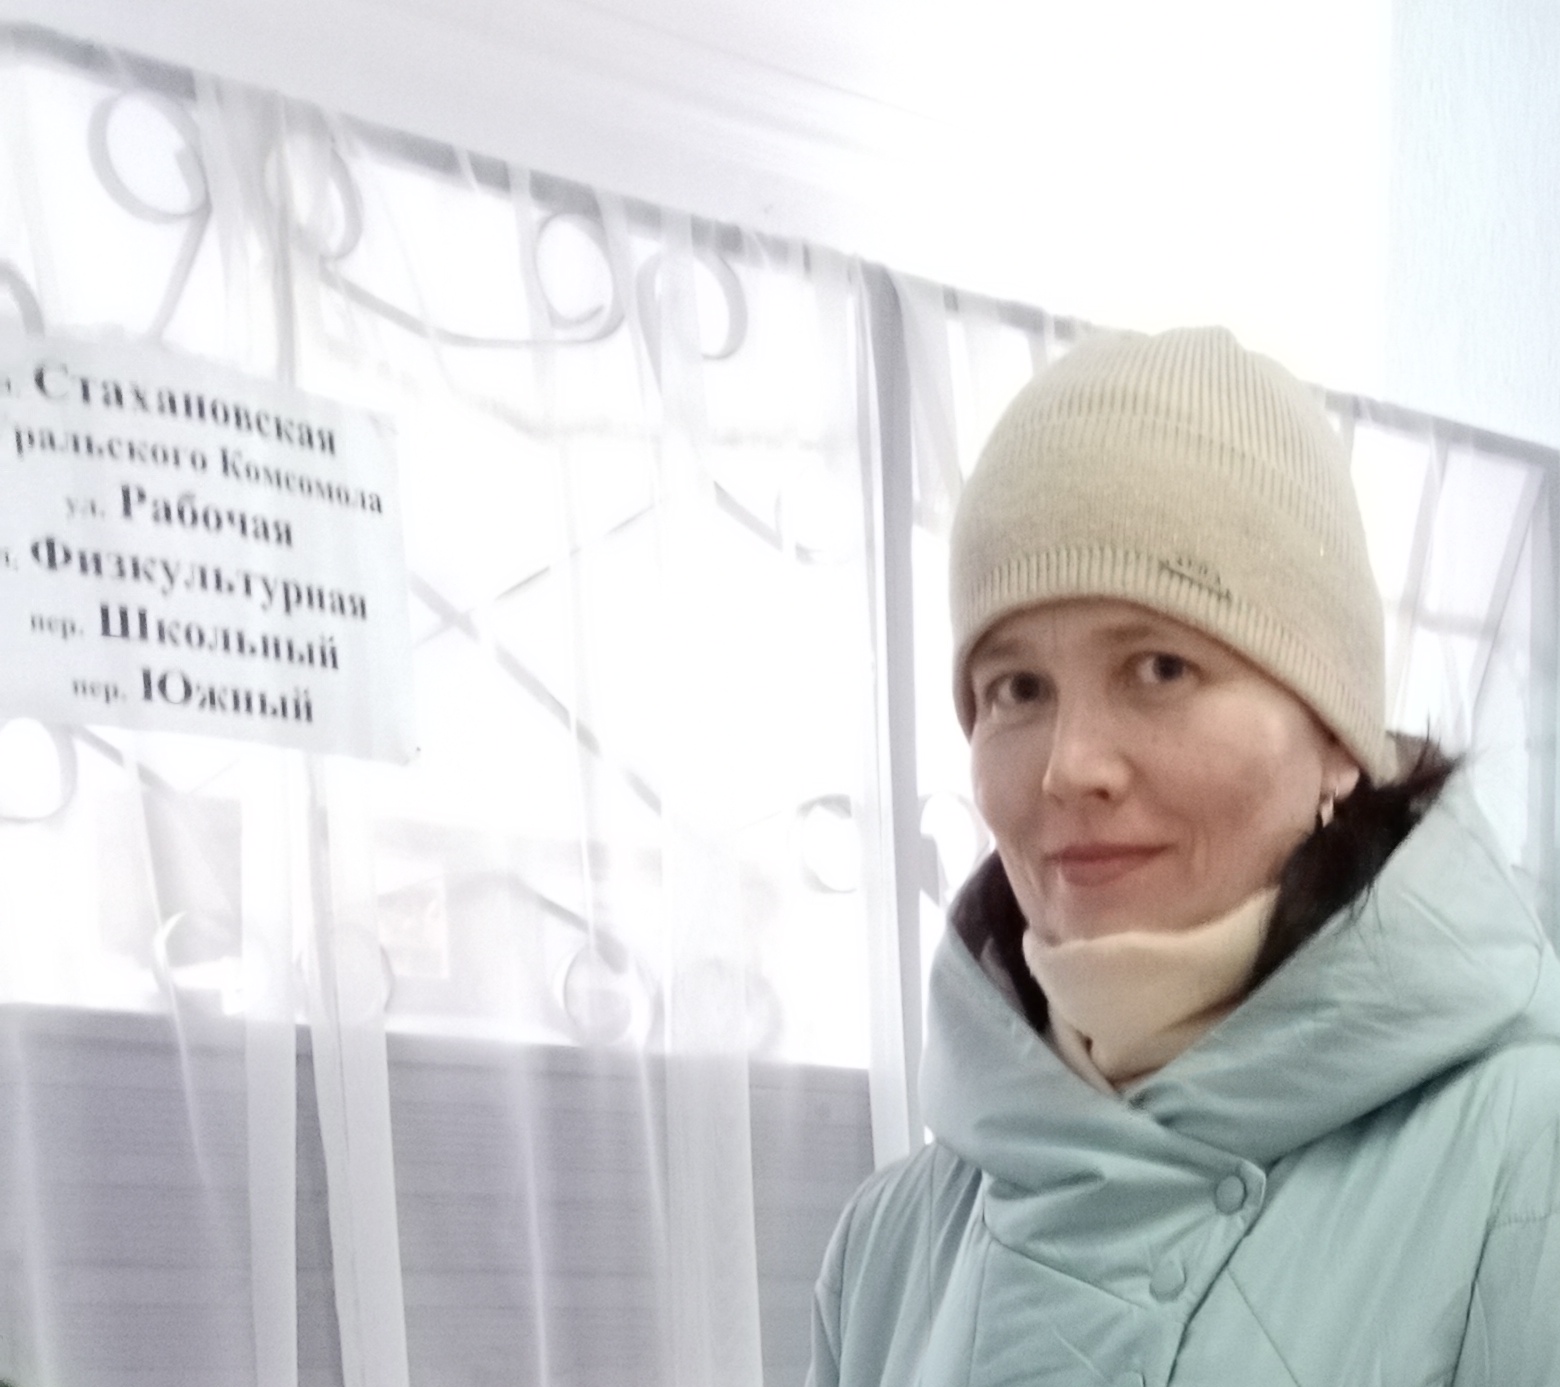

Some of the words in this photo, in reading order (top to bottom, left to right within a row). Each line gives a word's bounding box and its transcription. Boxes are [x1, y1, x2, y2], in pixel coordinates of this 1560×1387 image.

[33, 362, 336, 456] Стахановская
[13, 424, 208, 473] ральского
[218, 445, 384, 515] Комсомола
[120, 482, 294, 548] Рабочая
[30, 534, 368, 622] Физкультурная
[99, 602, 340, 670] Школьный
[140, 666, 314, 724] Южный
